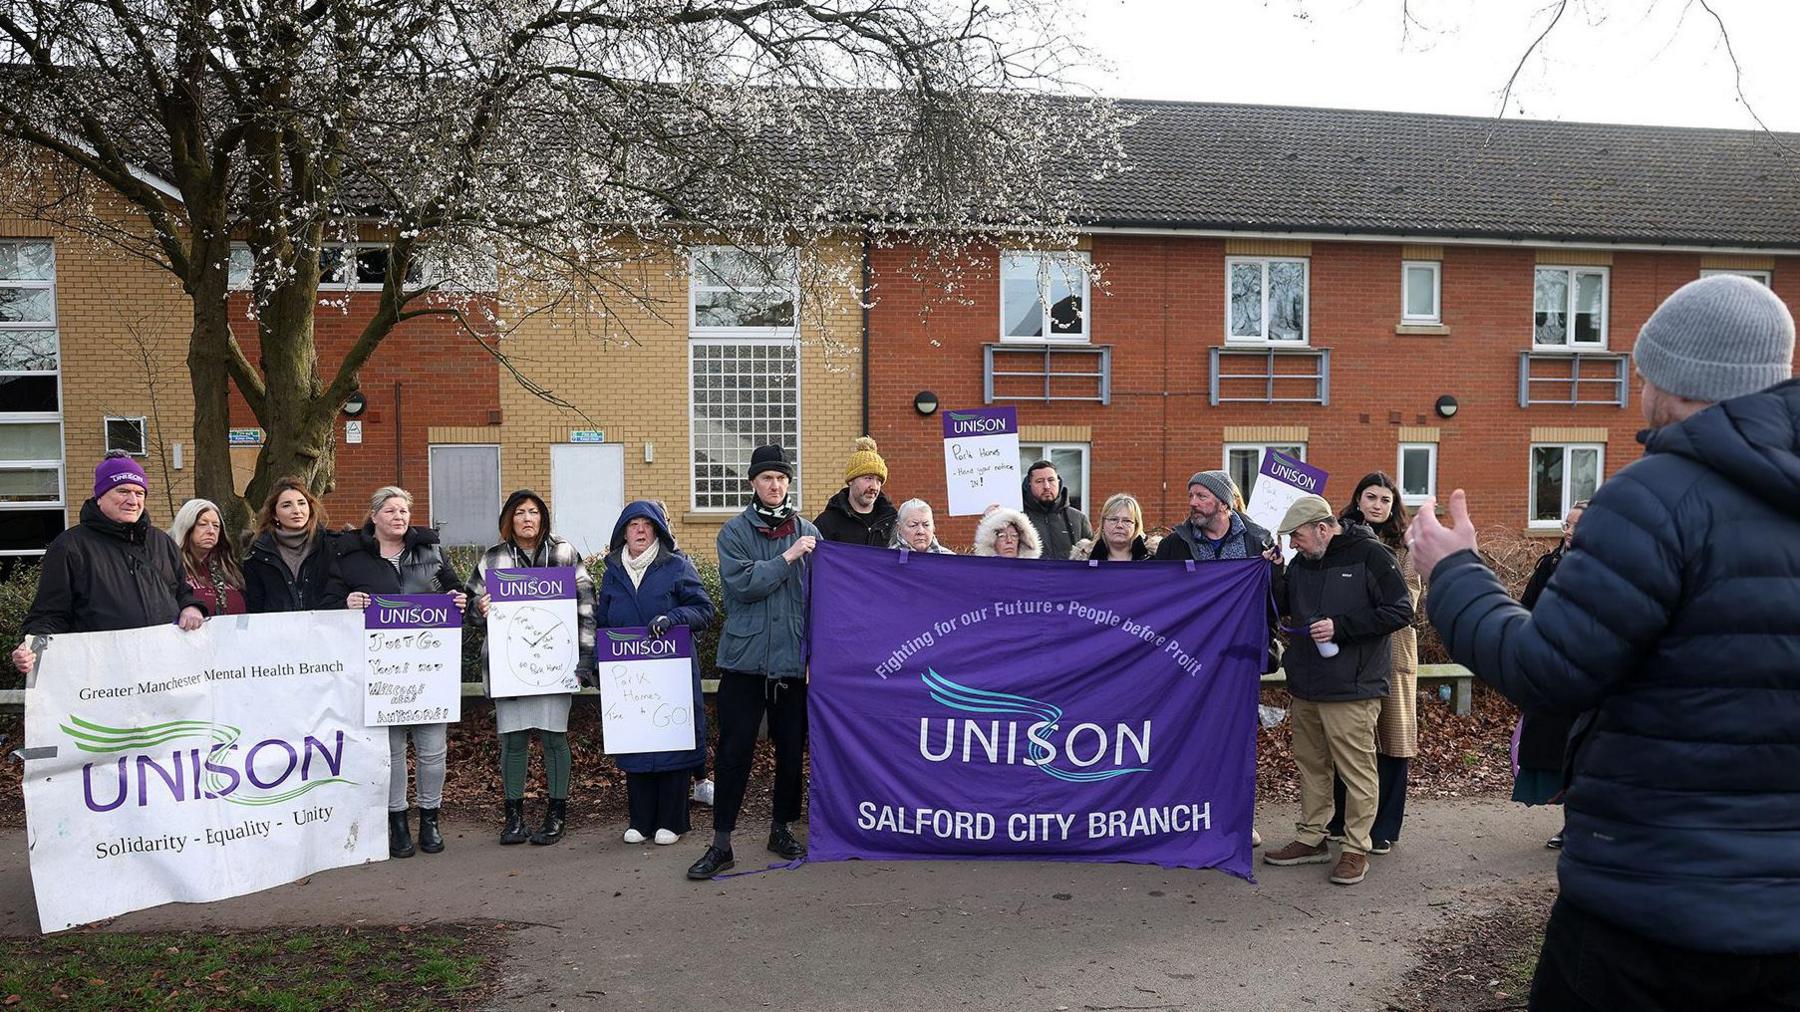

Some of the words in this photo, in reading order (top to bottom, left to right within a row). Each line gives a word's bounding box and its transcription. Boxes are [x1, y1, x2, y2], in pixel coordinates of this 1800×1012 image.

[954, 418, 1006, 433] UNISON
[952, 443, 973, 461] Park
[111, 473, 144, 482] UNISON
[1271, 462, 1317, 490] UNISON
[500, 580, 563, 597] UNISON
[380, 608, 448, 624] UNISON
[612, 639, 676, 656] UNISON
[874, 631, 935, 680] Fighting
[934, 617, 957, 637] for
[960, 607, 988, 626] our
[994, 600, 1052, 617] Future
[1068, 600, 1120, 627] People
[1122, 617, 1166, 647] before
[79, 686, 134, 701] Greater
[137, 673, 201, 695] Manchester
[204, 666, 246, 681] Mental
[251, 663, 295, 678] Health
[299, 660, 344, 675] Branch
[623, 689, 662, 703] Homes
[919, 717, 1152, 767] UNISON
[83, 730, 344, 812] UNISON
[96, 834, 187, 860] Solidarity
[206, 819, 271, 846] Equality
[293, 806, 333, 826] Unity
[857, 801, 995, 841] SALFORD
[1007, 813, 1075, 842] CITY
[1088, 802, 1211, 839] BRANCH
